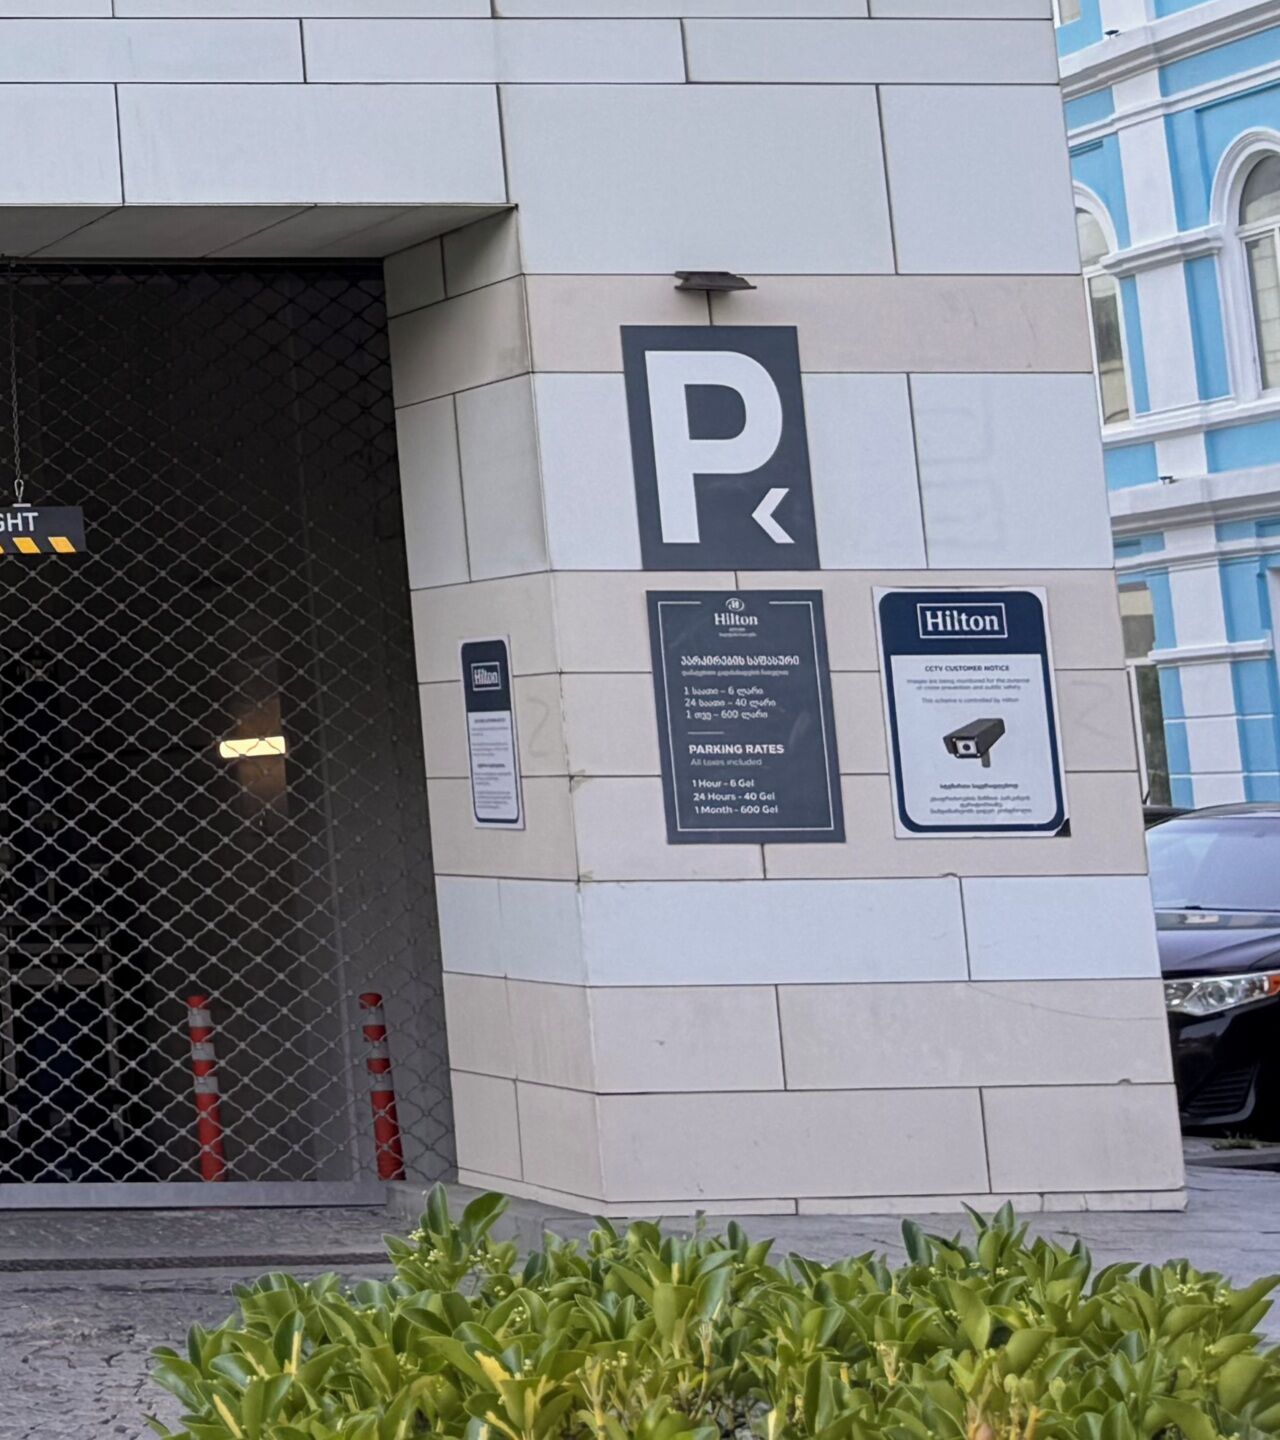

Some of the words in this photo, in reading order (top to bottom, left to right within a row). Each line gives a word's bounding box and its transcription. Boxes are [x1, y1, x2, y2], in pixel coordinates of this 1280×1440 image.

[644, 350, 783, 544] P
[714, 613, 759, 626] Hilton
[925, 610, 1000, 632] Hilton
[944, 664, 982, 672] CUSTOMER
[983, 664, 1010, 672] NOTICE
[473, 668, 499, 686] Hilton
[684, 686, 689, 696] 1
[728, 686, 734, 696] 6
[685, 698, 696, 707] 24
[735, 698, 747, 707] 40
[686, 710, 692, 719] 1
[720, 710, 739, 719] 600
[688, 744, 743, 755] PARKING
[745, 744, 785, 754] RATES
[690, 758, 701, 766] All
[726, 758, 763, 766] included
[692, 779, 697, 788] 1
[698, 779, 721, 788] Hour
[730, 779, 737, 788] 6
[738, 779, 755, 788] Gel
[693, 792, 706, 801] 24
[707, 792, 737, 801] Hours
[744, 792, 757, 801] 40
[759, 792, 776, 801] Gel
[695, 805, 700, 814] 1
[701, 805, 733, 814] Month
[740, 804, 760, 814] 600
[762, 804, 779, 814] Gel
